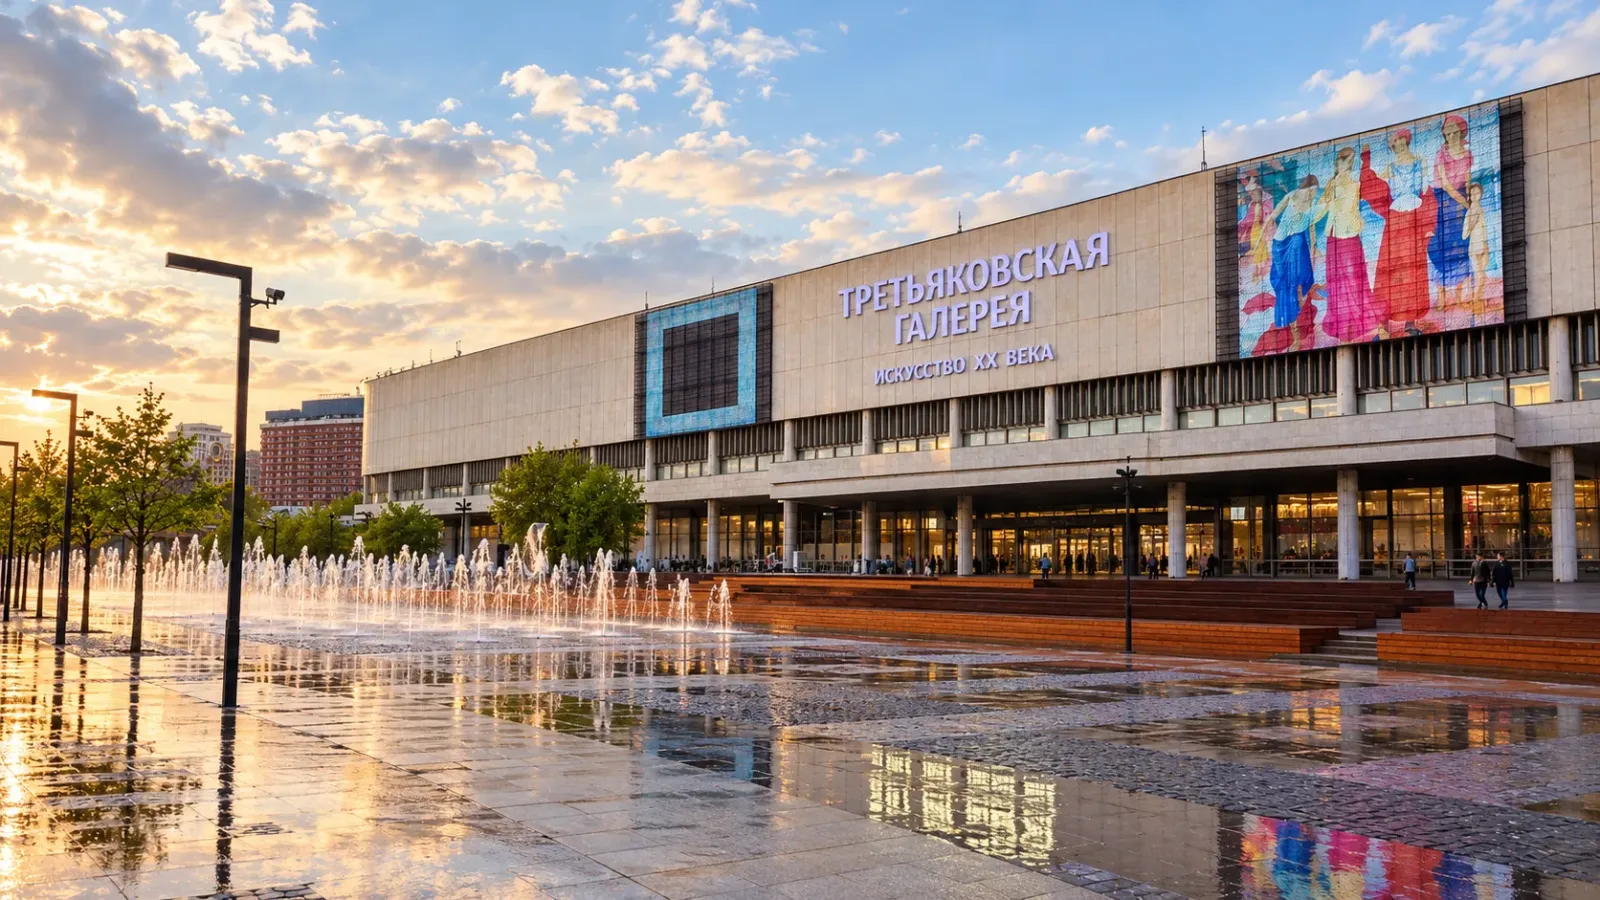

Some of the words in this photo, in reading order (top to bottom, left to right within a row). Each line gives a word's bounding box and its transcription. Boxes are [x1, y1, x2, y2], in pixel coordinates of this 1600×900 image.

[838, 231, 1109, 318] ТРЕТЬЯКОВСКАЯ
[895, 291, 1032, 345] ГАЛЕРЕЯ
[874, 357, 966, 385] ИСКУССТВО
[1006, 343, 1055, 366] ВЕКА
